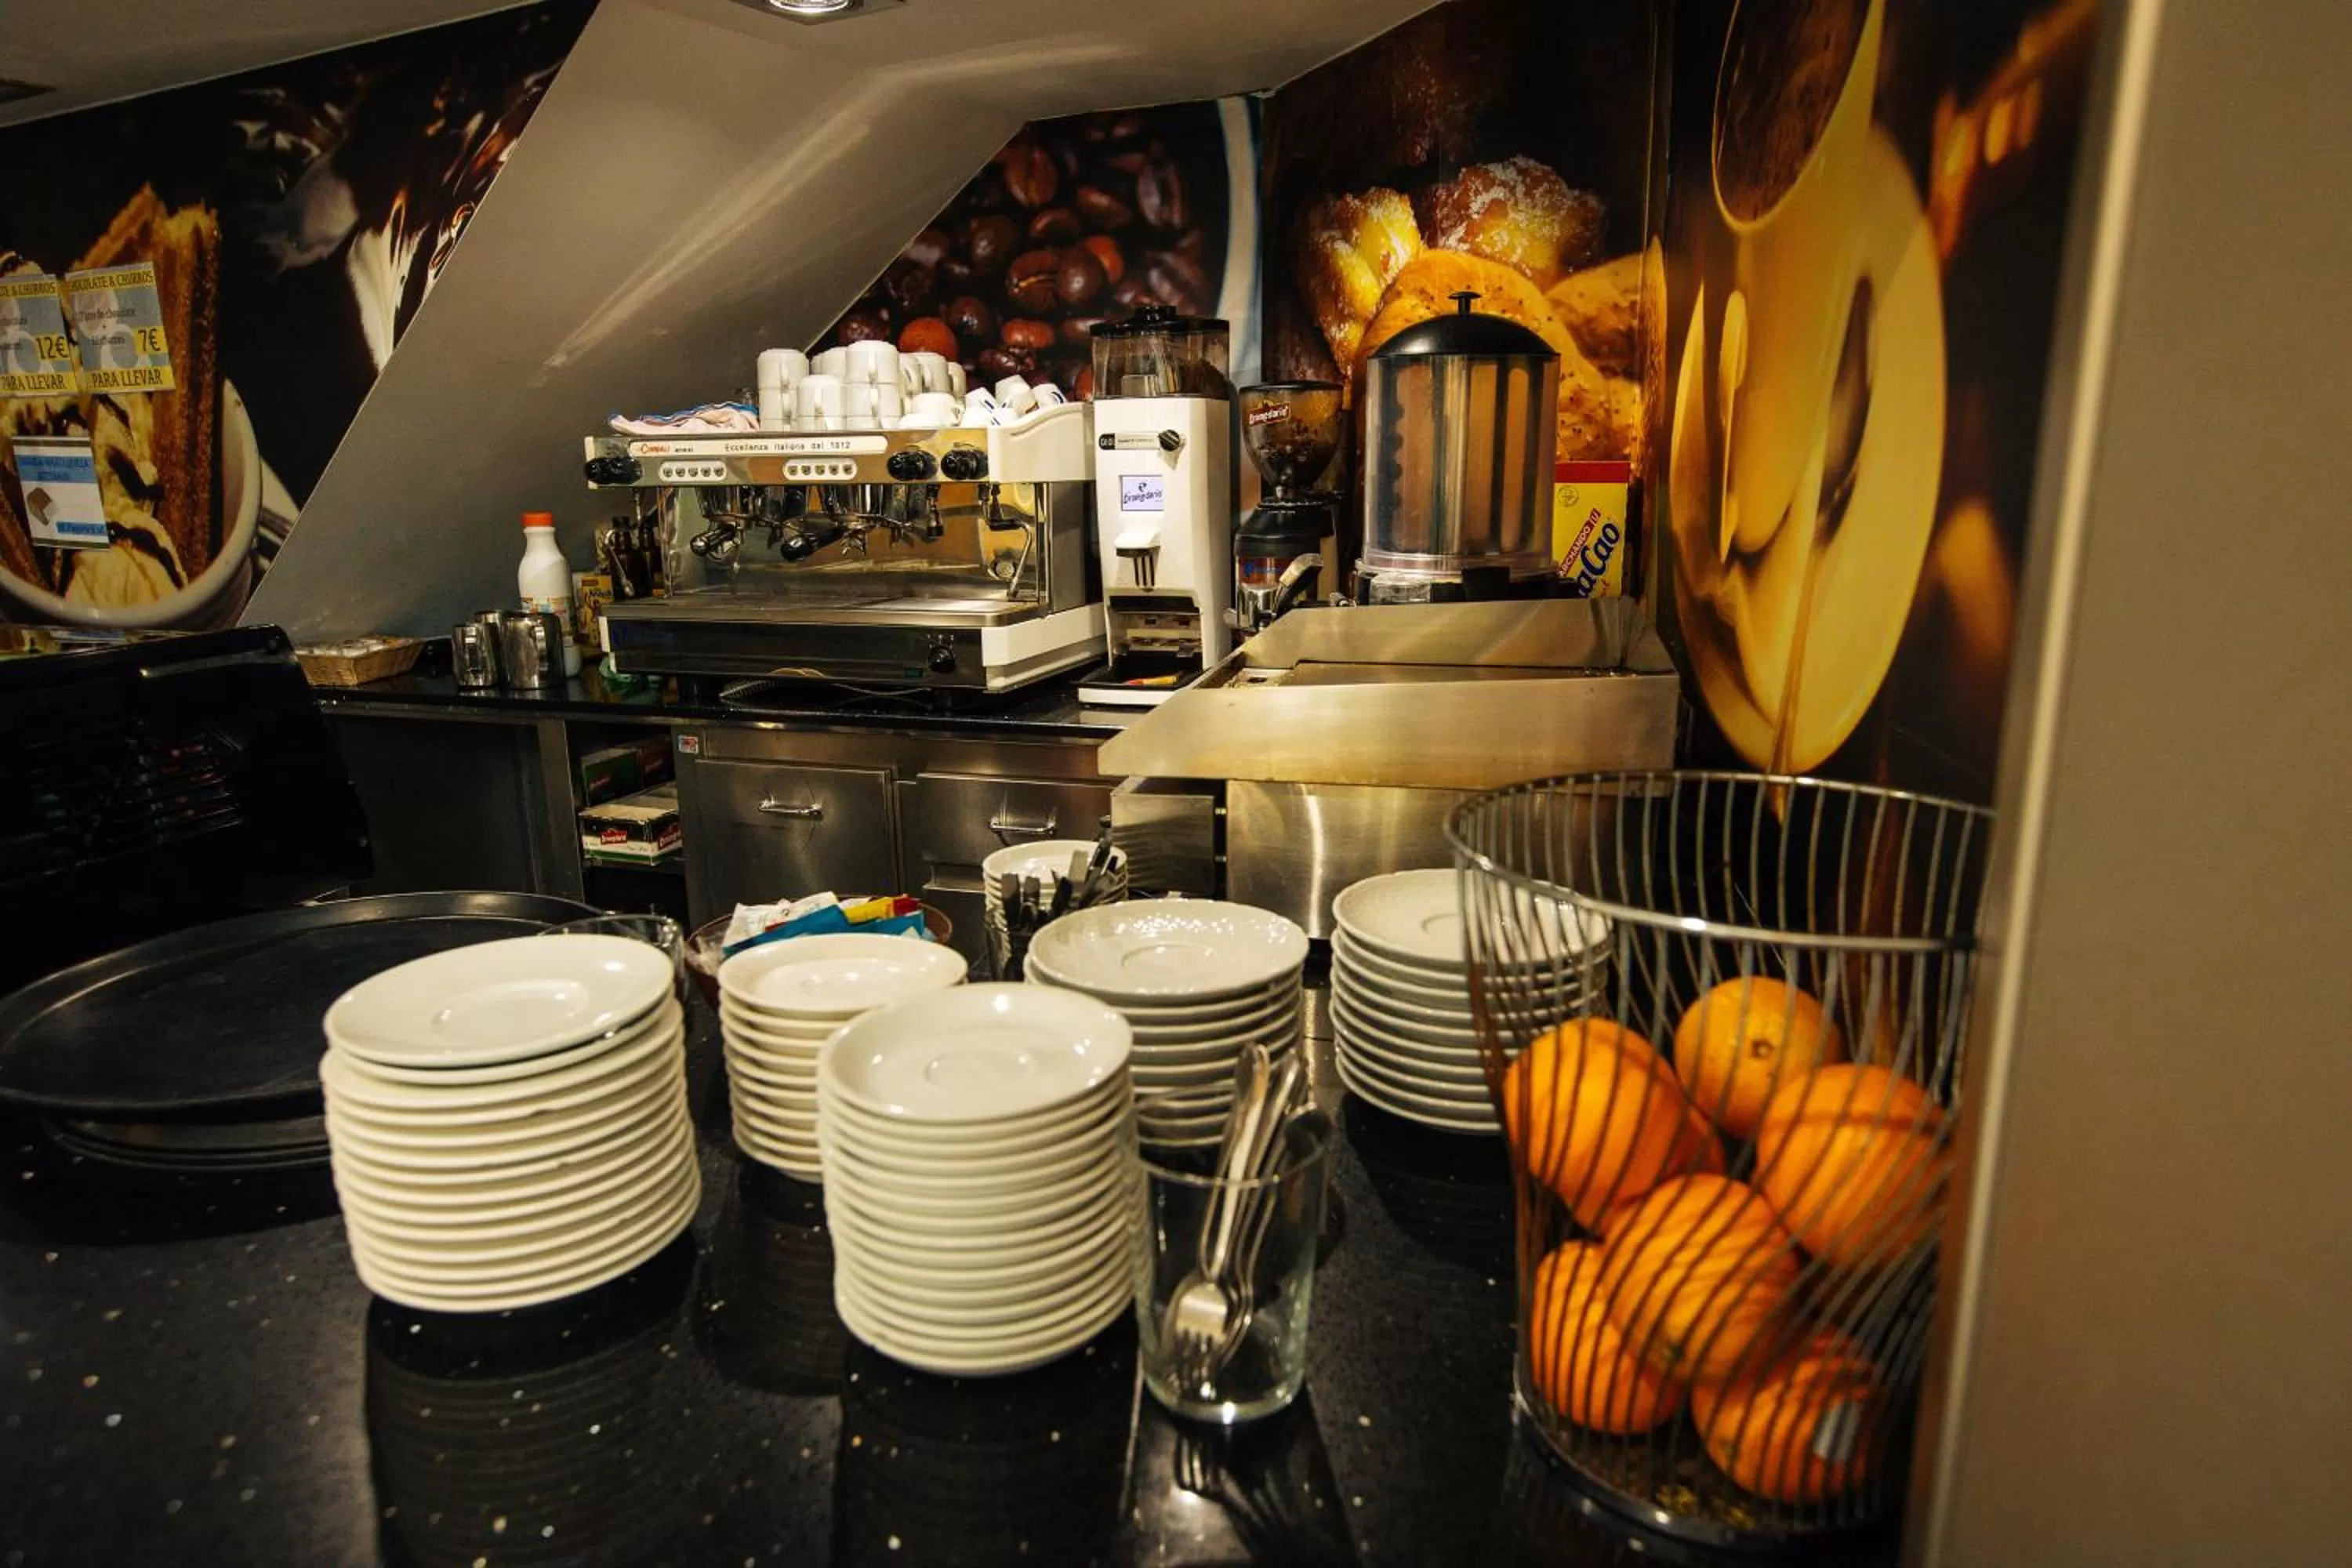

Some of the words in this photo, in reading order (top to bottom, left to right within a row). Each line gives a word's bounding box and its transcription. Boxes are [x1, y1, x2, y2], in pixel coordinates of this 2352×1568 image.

[36, 336, 71, 360] 12€
[138, 328, 161, 352] 7€
[25, 374, 67, 390] LLEVAR
[92, 372, 119, 388] PARA
[121, 368, 163, 386] LLEVAR
[1559, 525, 1592, 577] ARCHANDO
